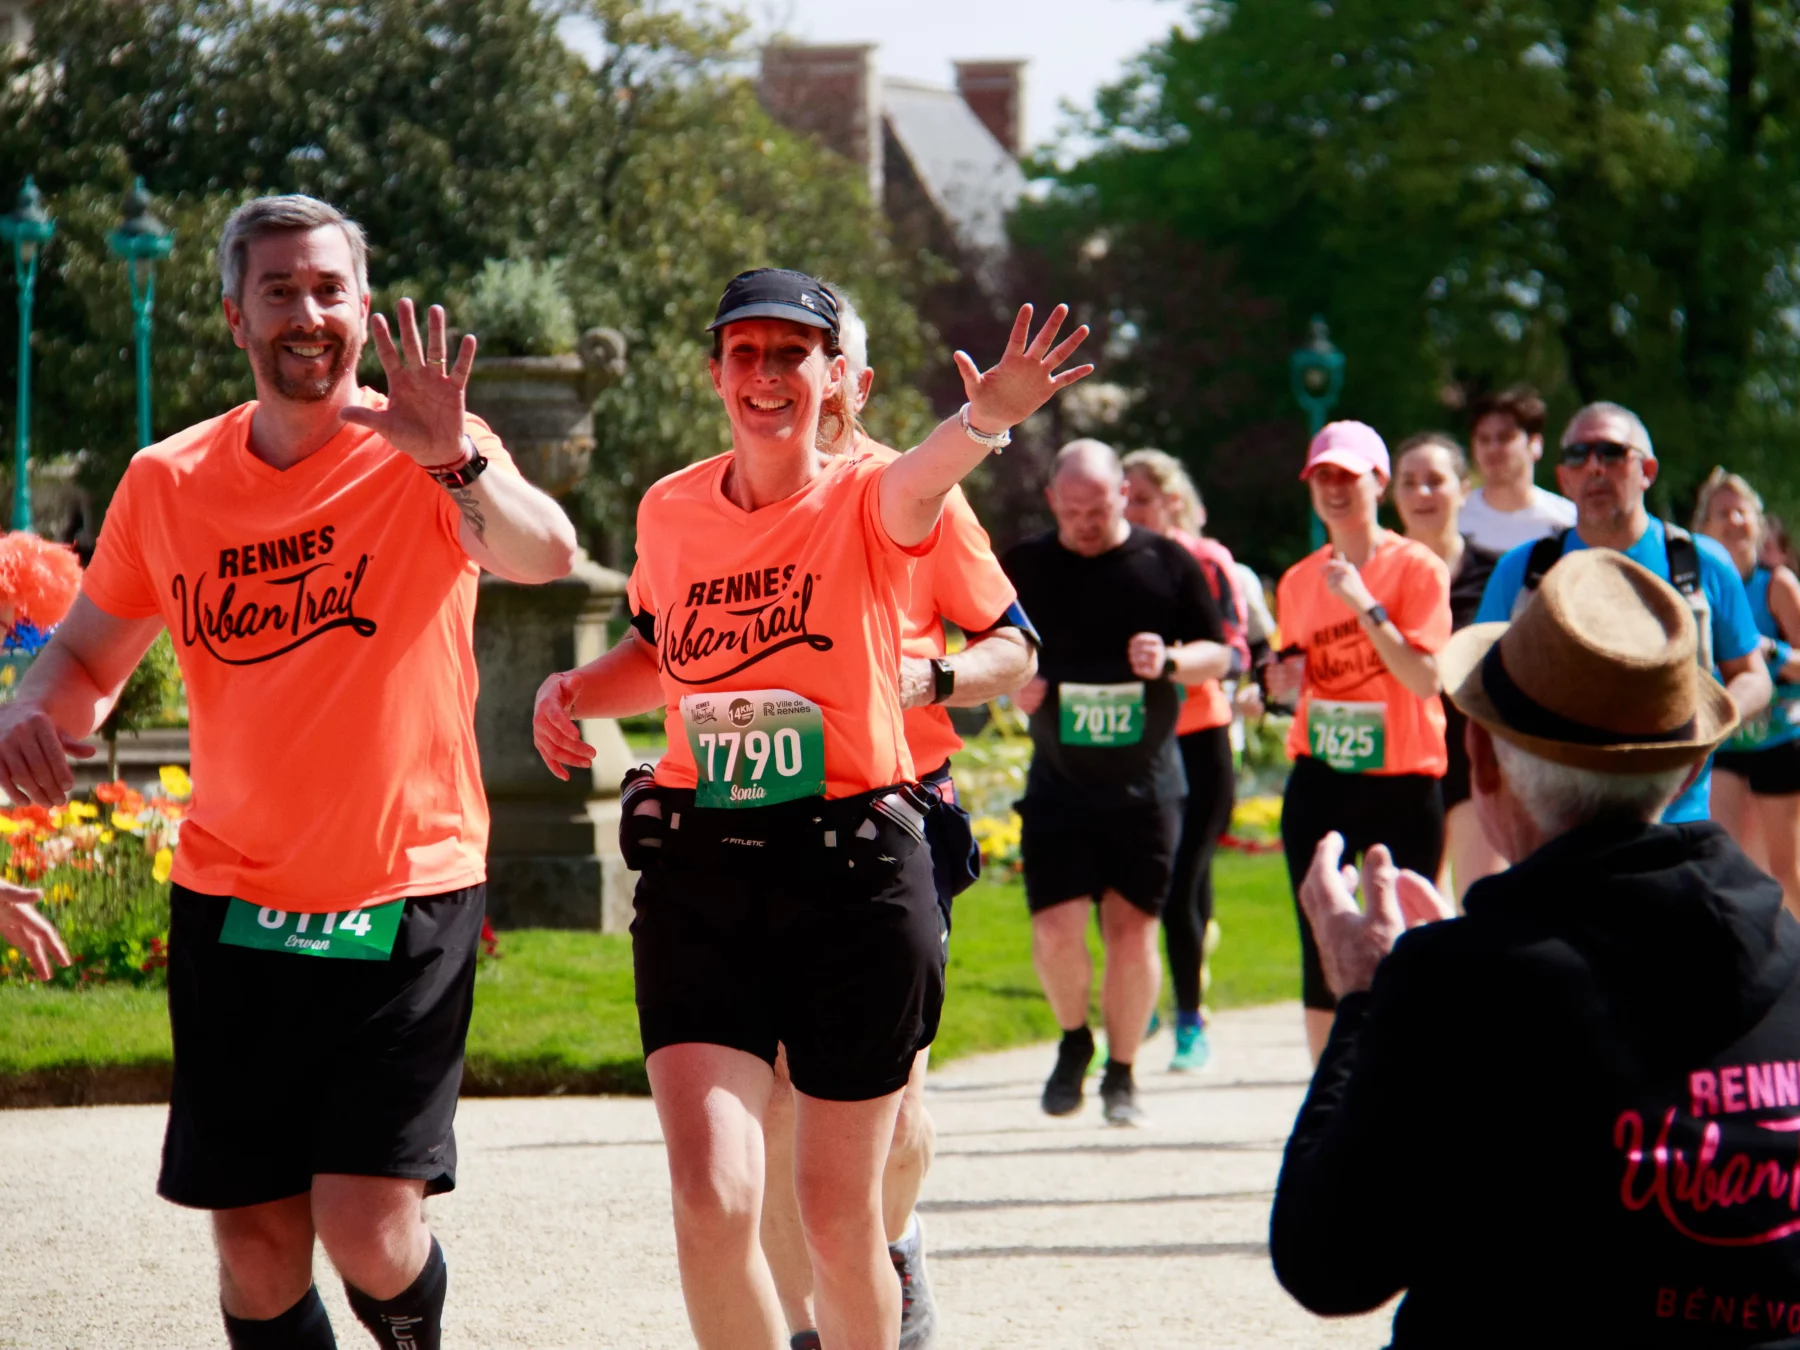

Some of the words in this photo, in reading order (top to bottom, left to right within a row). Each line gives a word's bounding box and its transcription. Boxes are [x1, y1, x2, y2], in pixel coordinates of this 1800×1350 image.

[219, 525, 335, 579] RENNES
[172, 570, 289, 647] Urban
[264, 553, 377, 638] Trail
[685, 564, 796, 608] RENNES
[654, 600, 742, 674] Urban
[725, 573, 834, 655] Trail
[1072, 704, 1132, 733] 7012
[1313, 723, 1374, 757] 7625
[698, 728, 803, 782] 7790
[730, 783, 766, 801] Sonia
[729, 838, 766, 847] FITLETIC
[285, 934, 331, 951] Erwan
[1689, 1060, 1800, 1118] RENN
[1613, 1106, 1789, 1212] Urban
